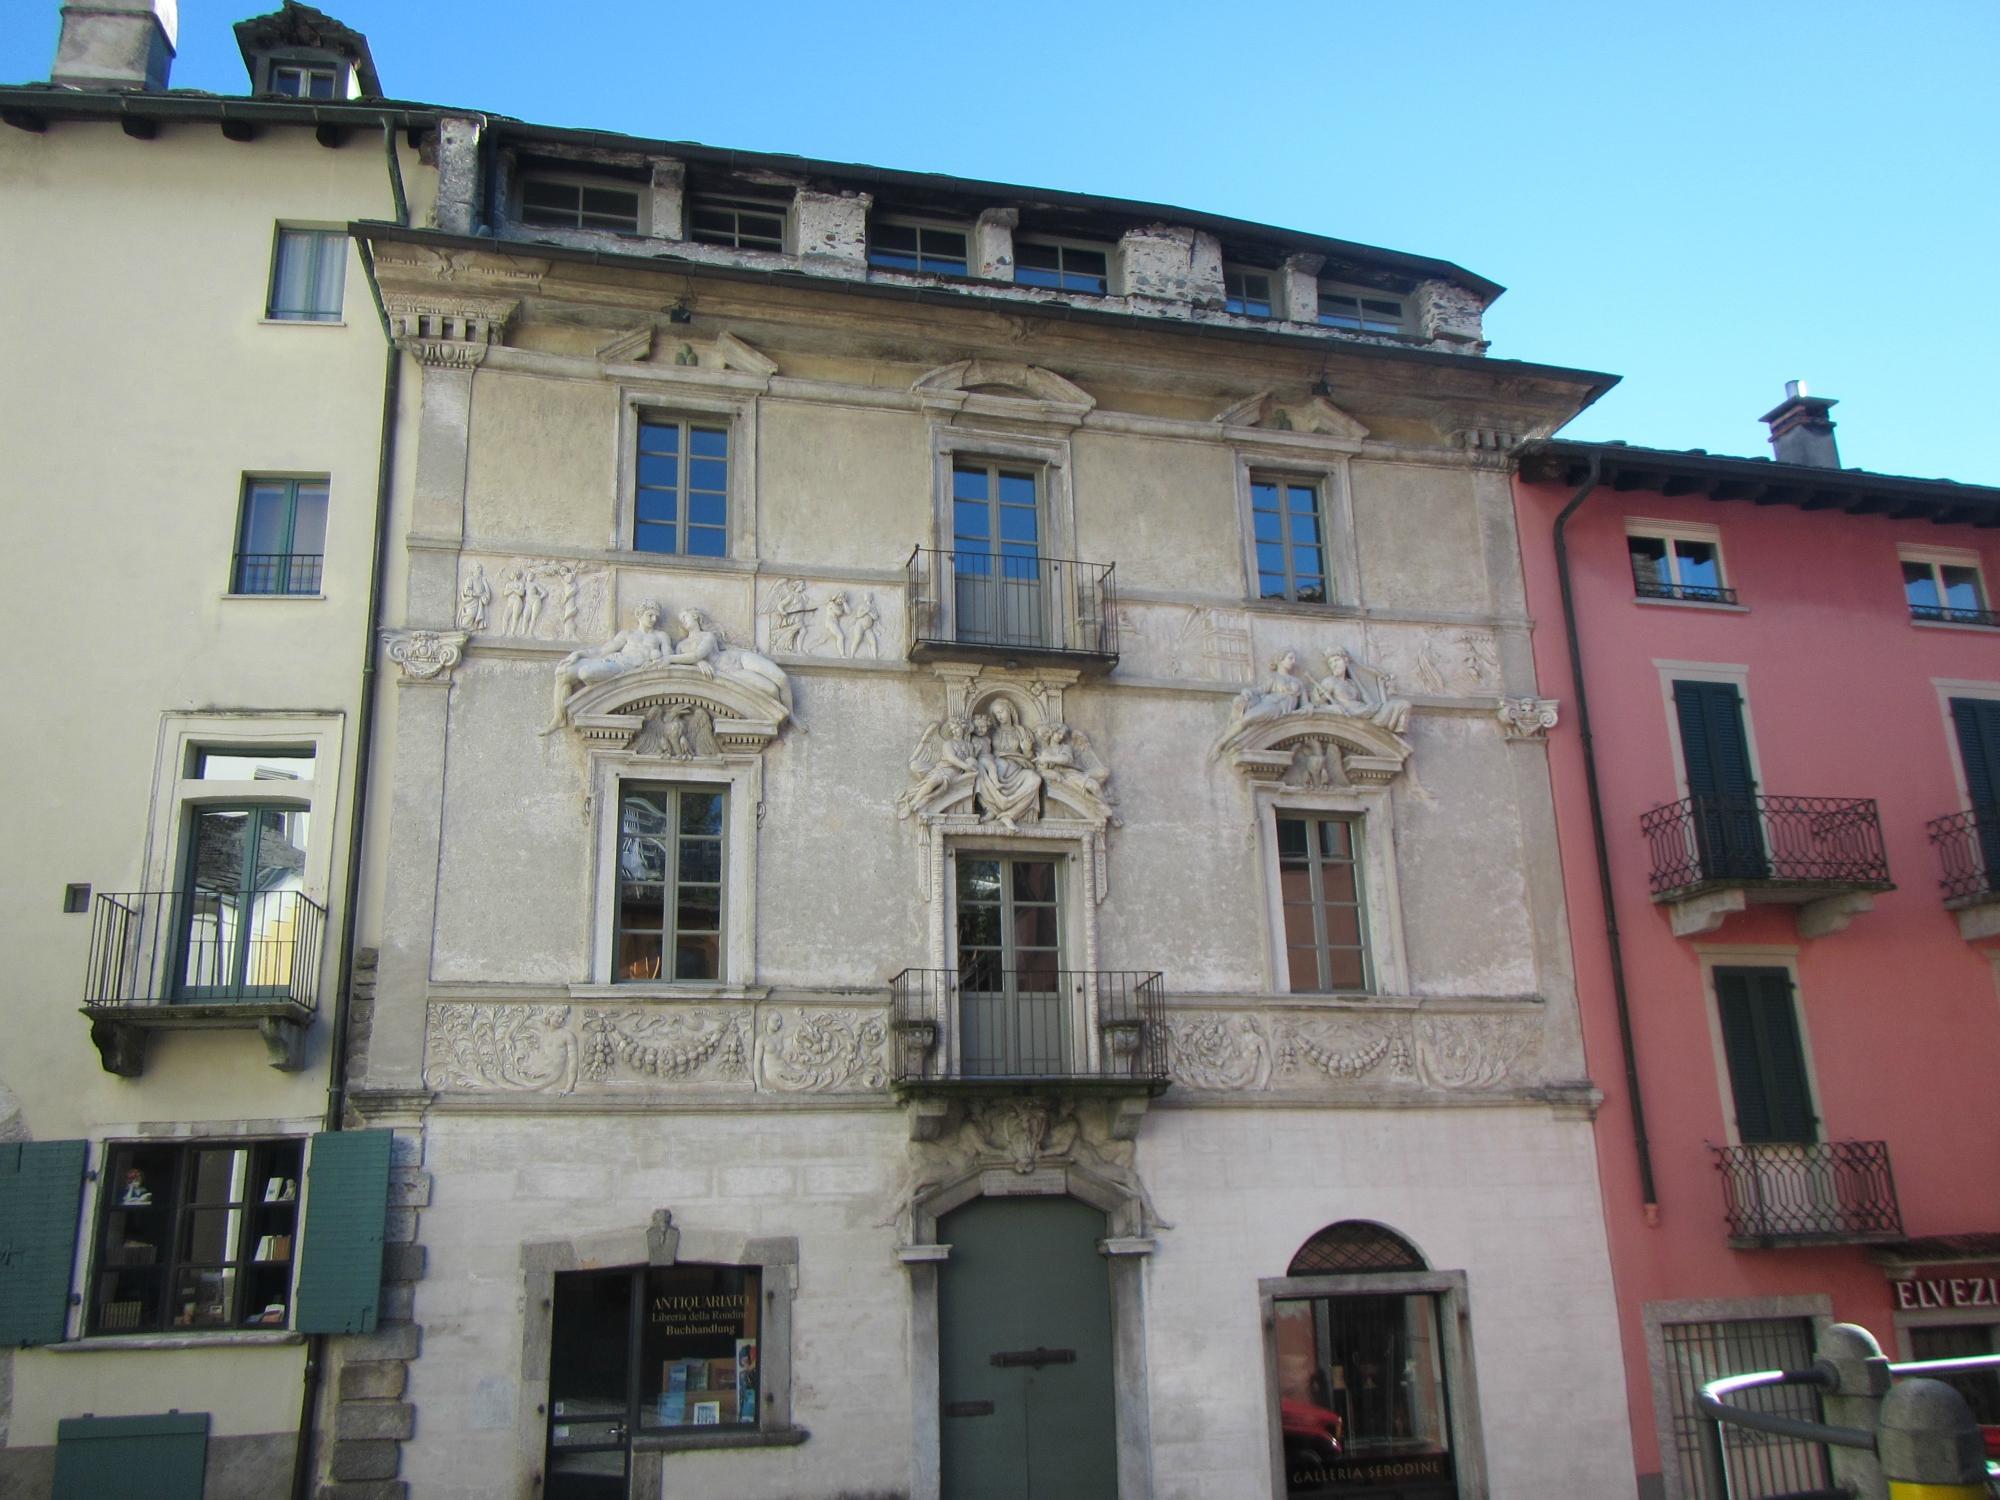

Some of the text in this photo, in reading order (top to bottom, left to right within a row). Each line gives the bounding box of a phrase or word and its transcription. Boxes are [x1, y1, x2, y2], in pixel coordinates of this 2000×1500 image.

[1896, 1278, 2000, 1309] ELVEZI
[653, 1295, 749, 1311] ANTIQUARIATO
[652, 1311, 687, 1322] Libreria
[689, 1310, 710, 1321] della
[665, 1323, 736, 1335] Buchhandlung
[1293, 1461, 1440, 1483] GALLERIA SERODINE
